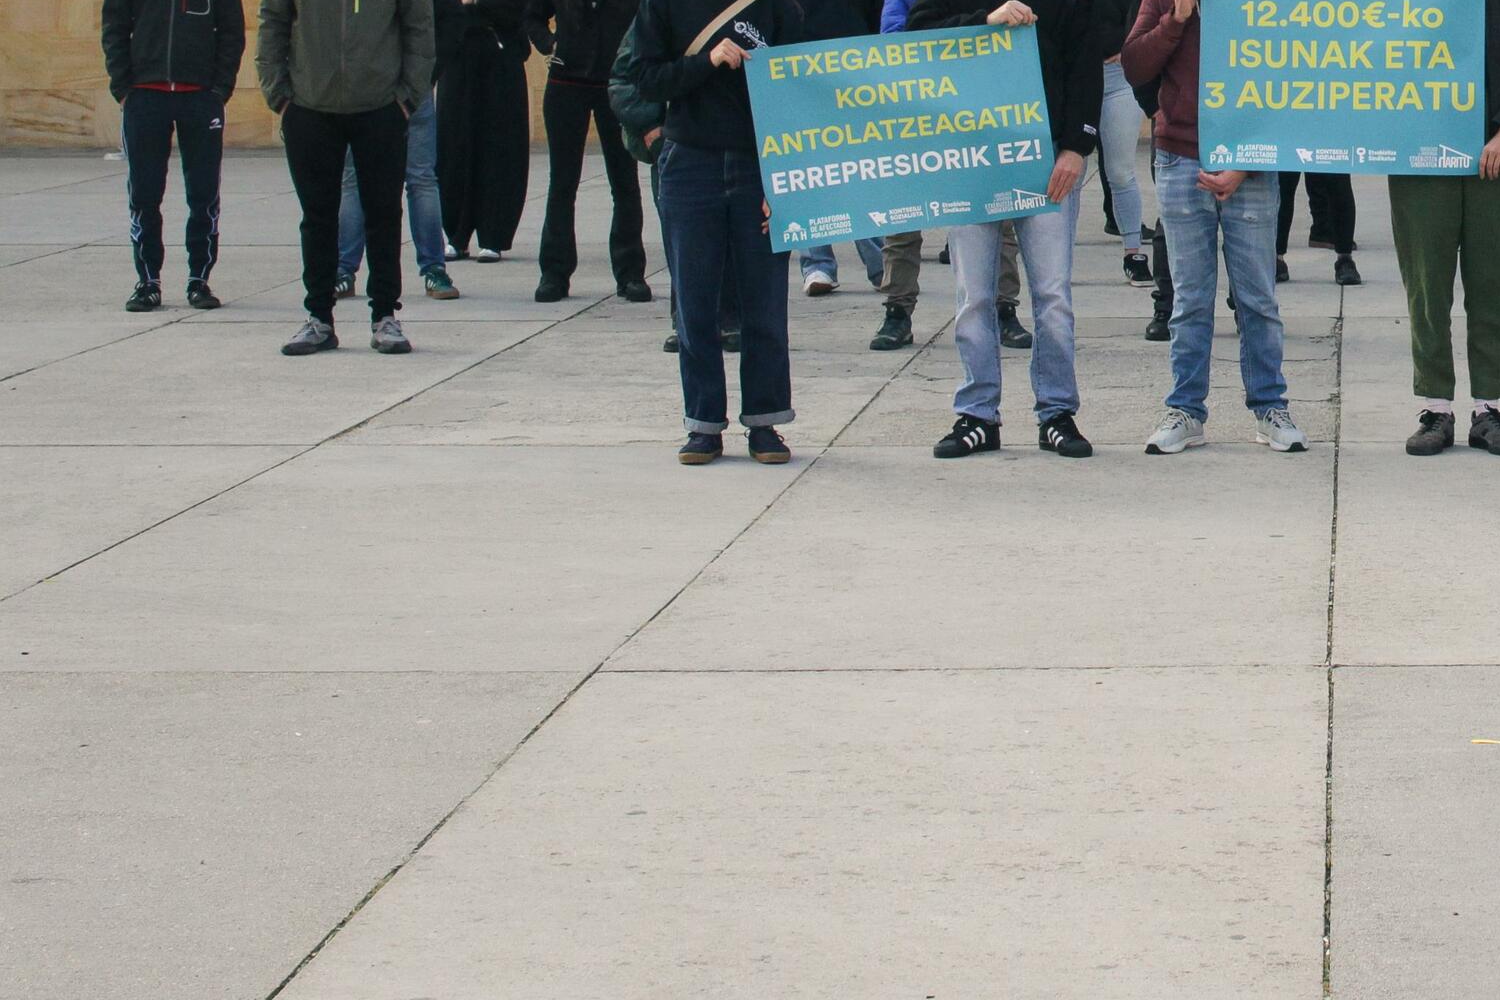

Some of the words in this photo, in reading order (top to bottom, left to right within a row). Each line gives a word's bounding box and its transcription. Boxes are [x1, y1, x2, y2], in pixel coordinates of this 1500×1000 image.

[1241, 0, 1444, 28] 12.400€-ko
[768, 30, 1013, 80] ETXEGABETZEEN
[1229, 39, 1374, 69] ISUNAK
[1385, 40, 1455, 70] ETA
[835, 76, 958, 109] KONTRA
[1204, 81, 1226, 108] 3
[1235, 80, 1475, 112] AUZIPERATU
[761, 101, 1044, 158] ANTOLATZEAGATIK
[1210, 154, 1233, 164] PAH
[1237, 144, 1277, 152] PLATAFORMA
[771, 145, 991, 195] ERREPRESIORIK
[998, 139, 1042, 165] EZ!
[808, 213, 851, 226] PLATAFORMA
[783, 231, 807, 243] PAH
